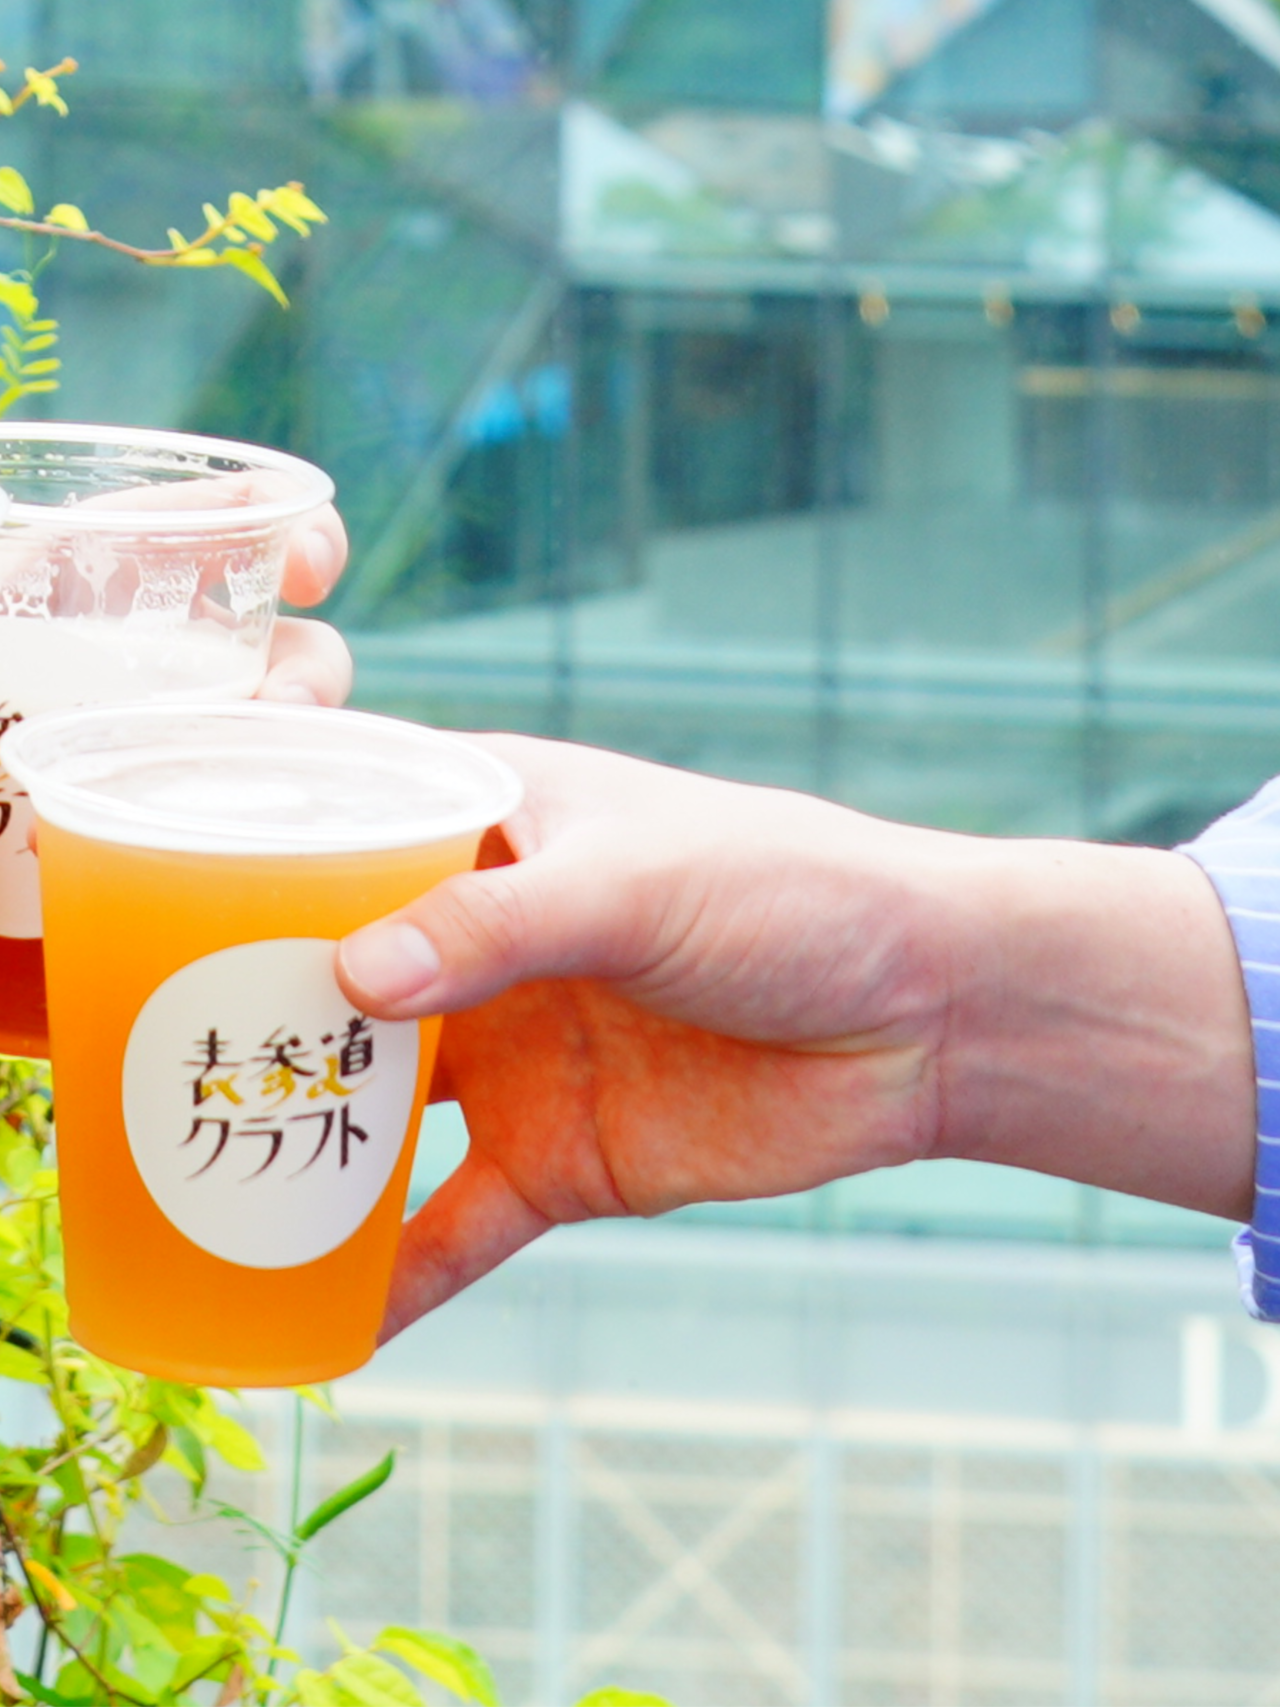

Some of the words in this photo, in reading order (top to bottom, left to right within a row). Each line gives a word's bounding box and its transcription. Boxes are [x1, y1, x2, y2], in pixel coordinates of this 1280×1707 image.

[179, 1013, 377, 1112] 表参道
[177, 1101, 370, 1184] クラフト
